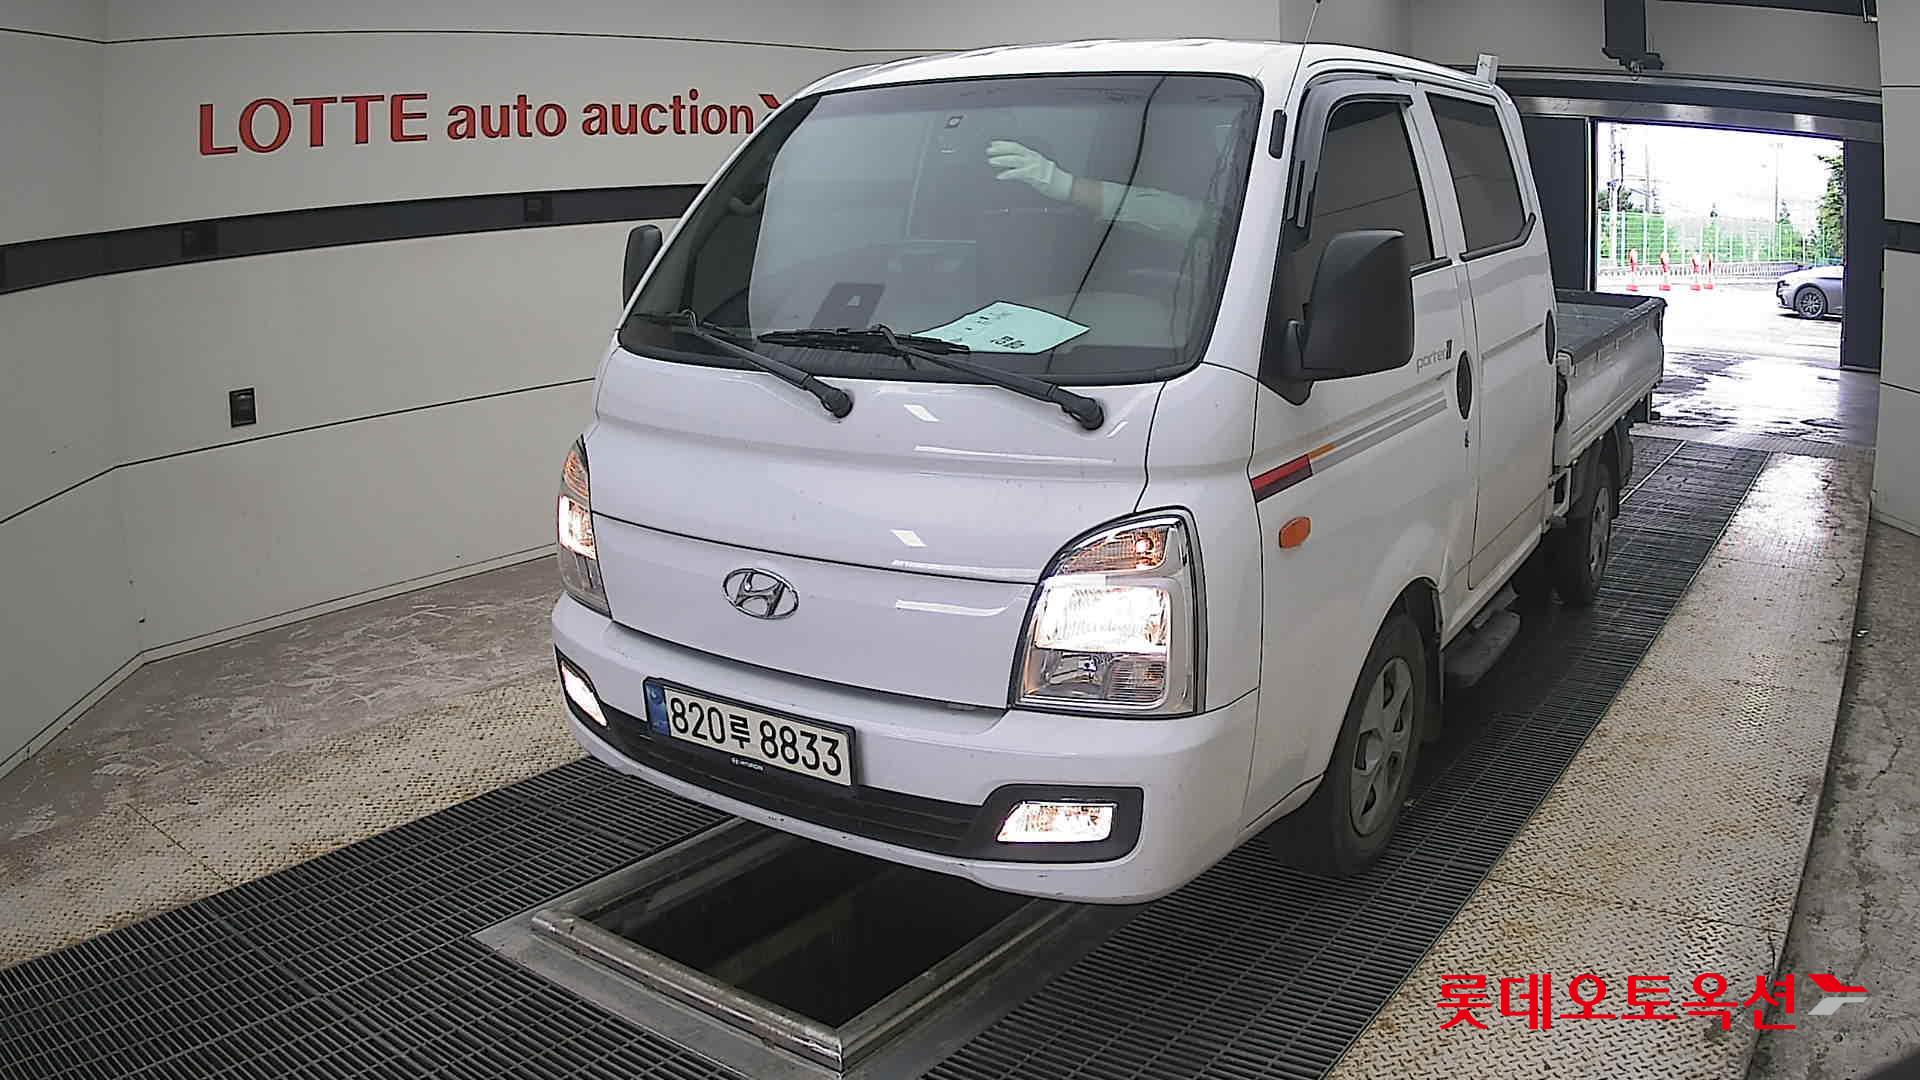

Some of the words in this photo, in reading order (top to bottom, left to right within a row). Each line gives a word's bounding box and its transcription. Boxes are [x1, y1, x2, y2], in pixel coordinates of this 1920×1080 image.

[199, 93, 428, 155] LOTTE
[447, 95, 567, 140] auto
[581, 89, 755, 136] auction
[670, 698, 750, 749] 820루
[759, 720, 842, 776] 8833
